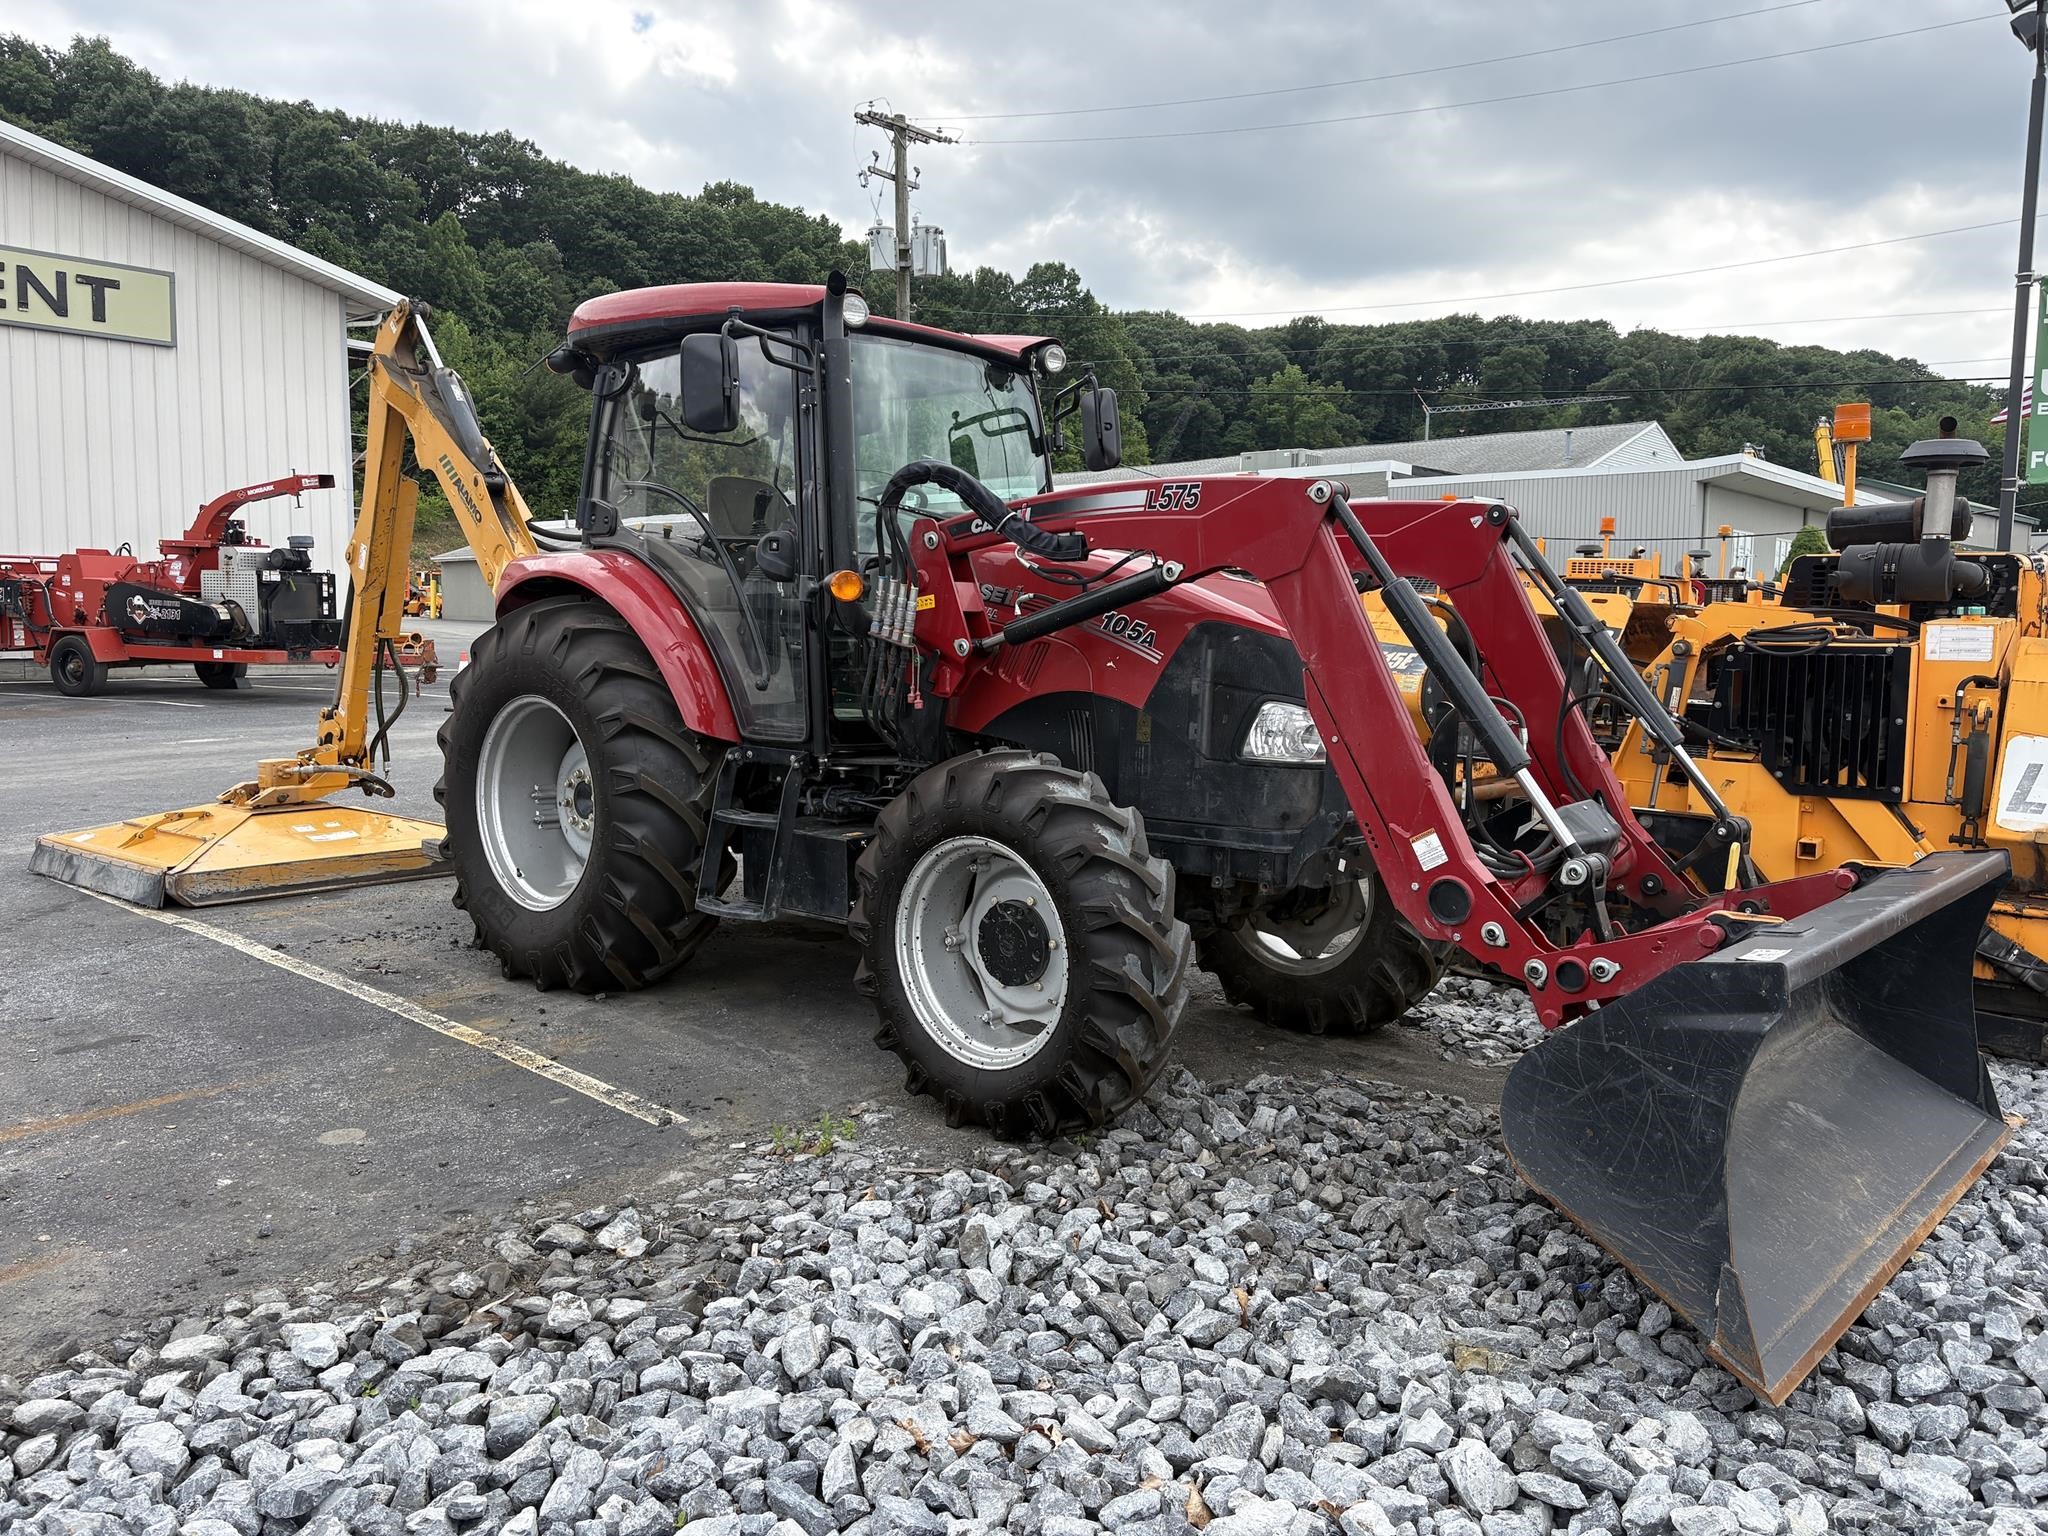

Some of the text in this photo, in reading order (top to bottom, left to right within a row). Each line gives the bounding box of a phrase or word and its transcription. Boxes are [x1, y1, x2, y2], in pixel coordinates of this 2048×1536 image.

[0, 261, 121, 323] NT
[1145, 482, 1202, 513] L575
[1101, 610, 1158, 649] 105A
